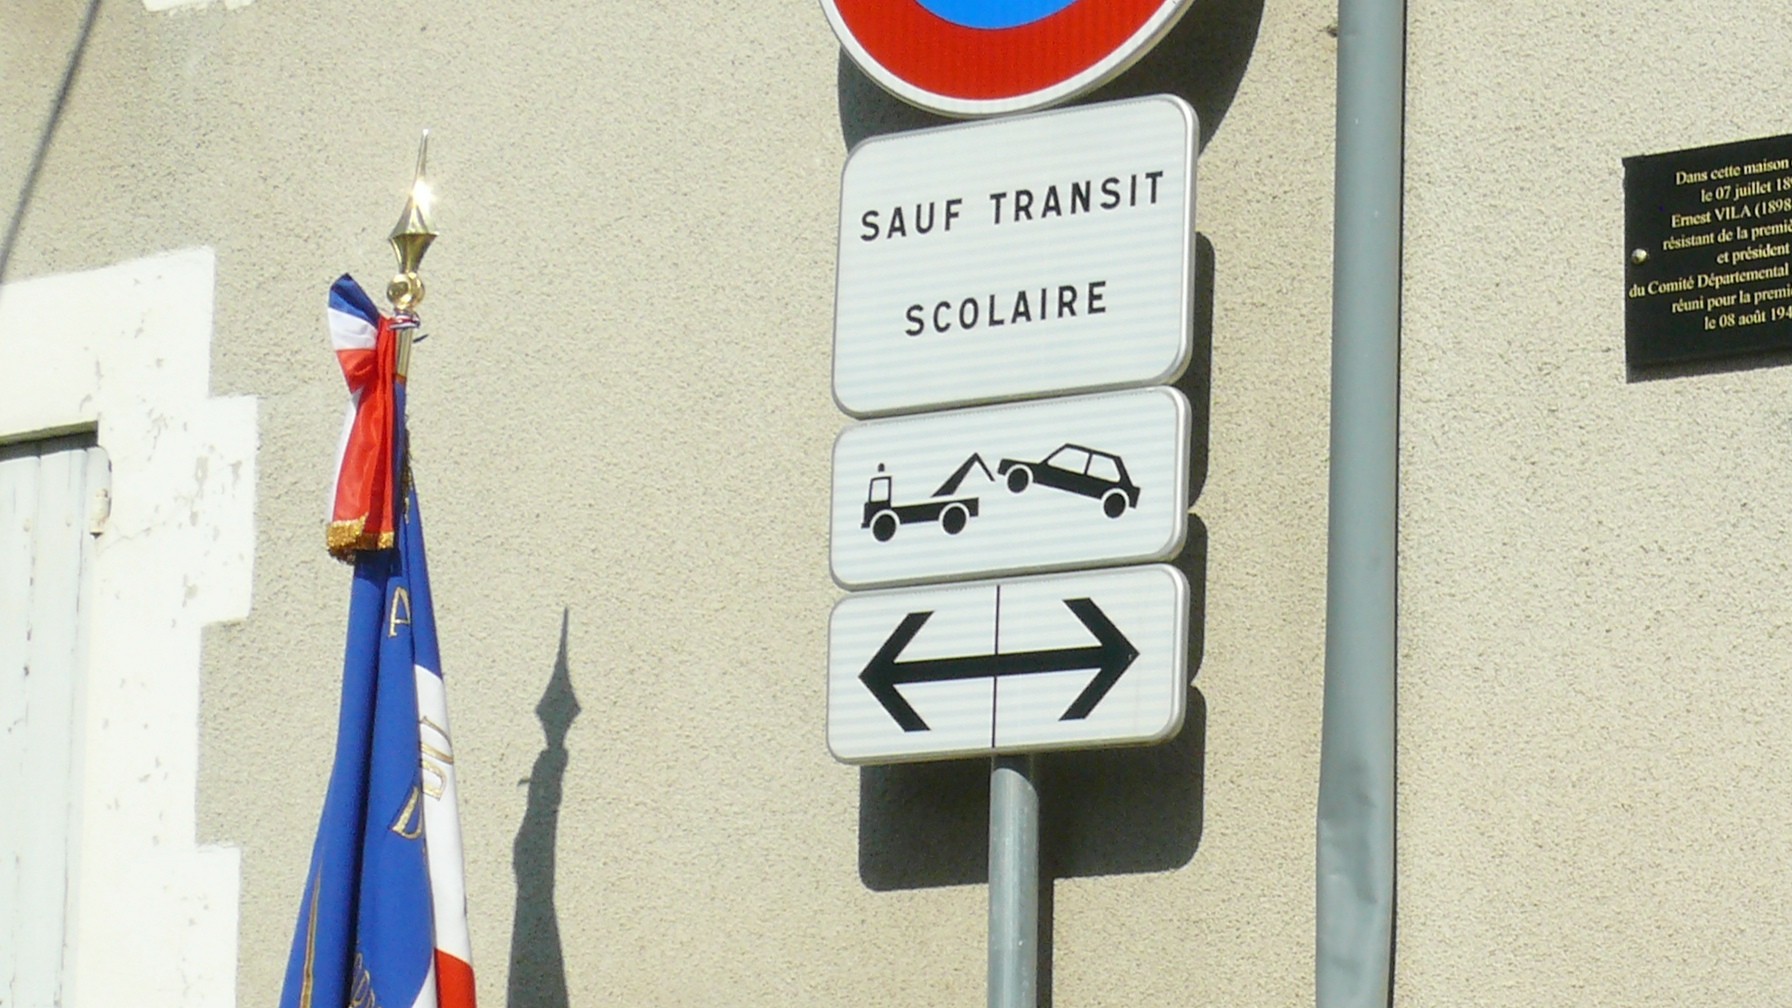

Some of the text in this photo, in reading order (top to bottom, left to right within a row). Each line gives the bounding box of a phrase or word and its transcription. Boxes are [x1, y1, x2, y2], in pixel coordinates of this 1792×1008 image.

[1675, 170, 1708, 186] Dans
[1710, 165, 1741, 181] cette
[1743, 158, 1789, 176] maison
[1701, 189, 1713, 203] le
[1715, 185, 1731, 200] 07
[1733, 181, 1772, 202] juillet
[860, 171, 1164, 243] SAUF TRANSIT
[1671, 211, 1711, 228] Ernest
[1714, 205, 1751, 221] VILA
[1662, 231, 1715, 251] résistant
[1717, 228, 1733, 243] de
[1736, 226, 1748, 241] la
[1716, 242, 1790, 265] et président
[1628, 283, 1645, 298] du
[1647, 275, 1695, 295] Comité
[1697, 262, 1789, 289] Départemental
[905, 280, 1108, 337] SCOLAIRE
[1671, 295, 1704, 313] réuni
[1707, 294, 1737, 311] pour
[1739, 289, 1751, 304] la
[1704, 316, 1716, 330] le
[1719, 312, 1736, 328] 08
[1738, 309, 1766, 326] août
